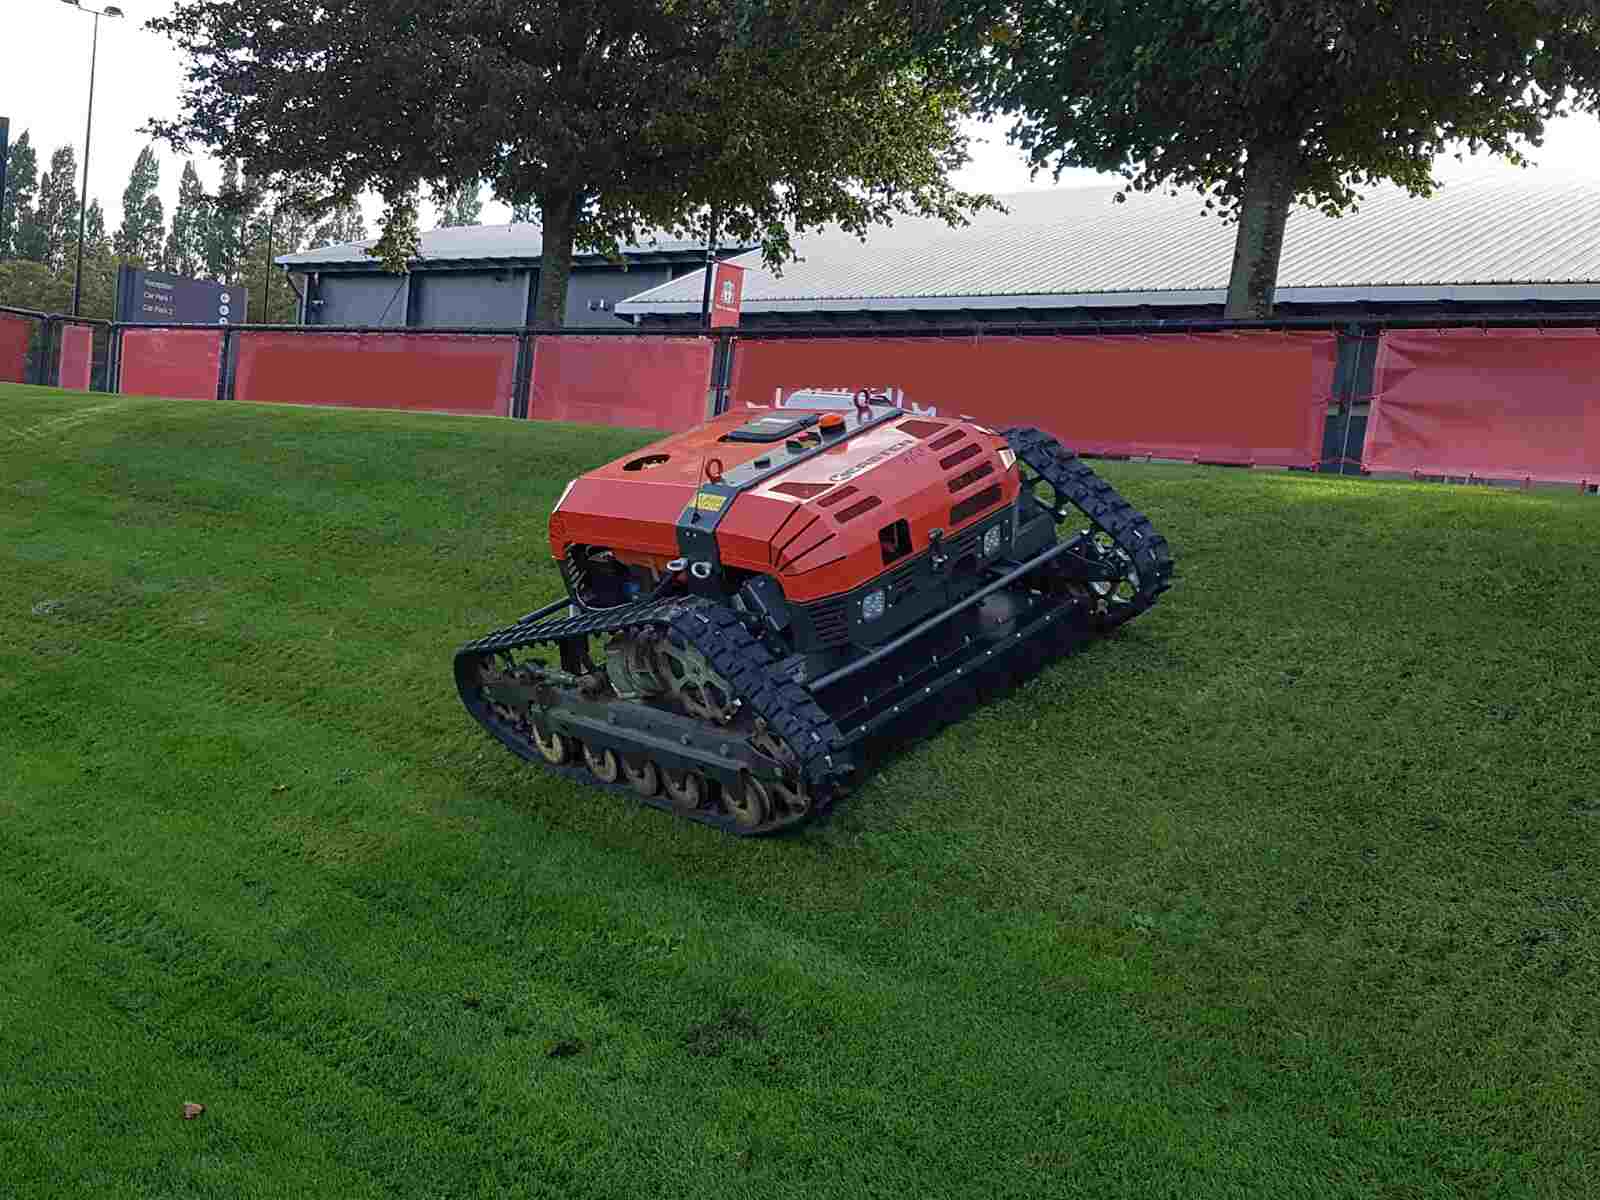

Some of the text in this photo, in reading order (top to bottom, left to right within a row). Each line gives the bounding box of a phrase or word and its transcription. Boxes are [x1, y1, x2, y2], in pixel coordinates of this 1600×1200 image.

[155, 293, 168, 301] Park
[143, 304, 154, 312] Car
[155, 305, 168, 313] Park
